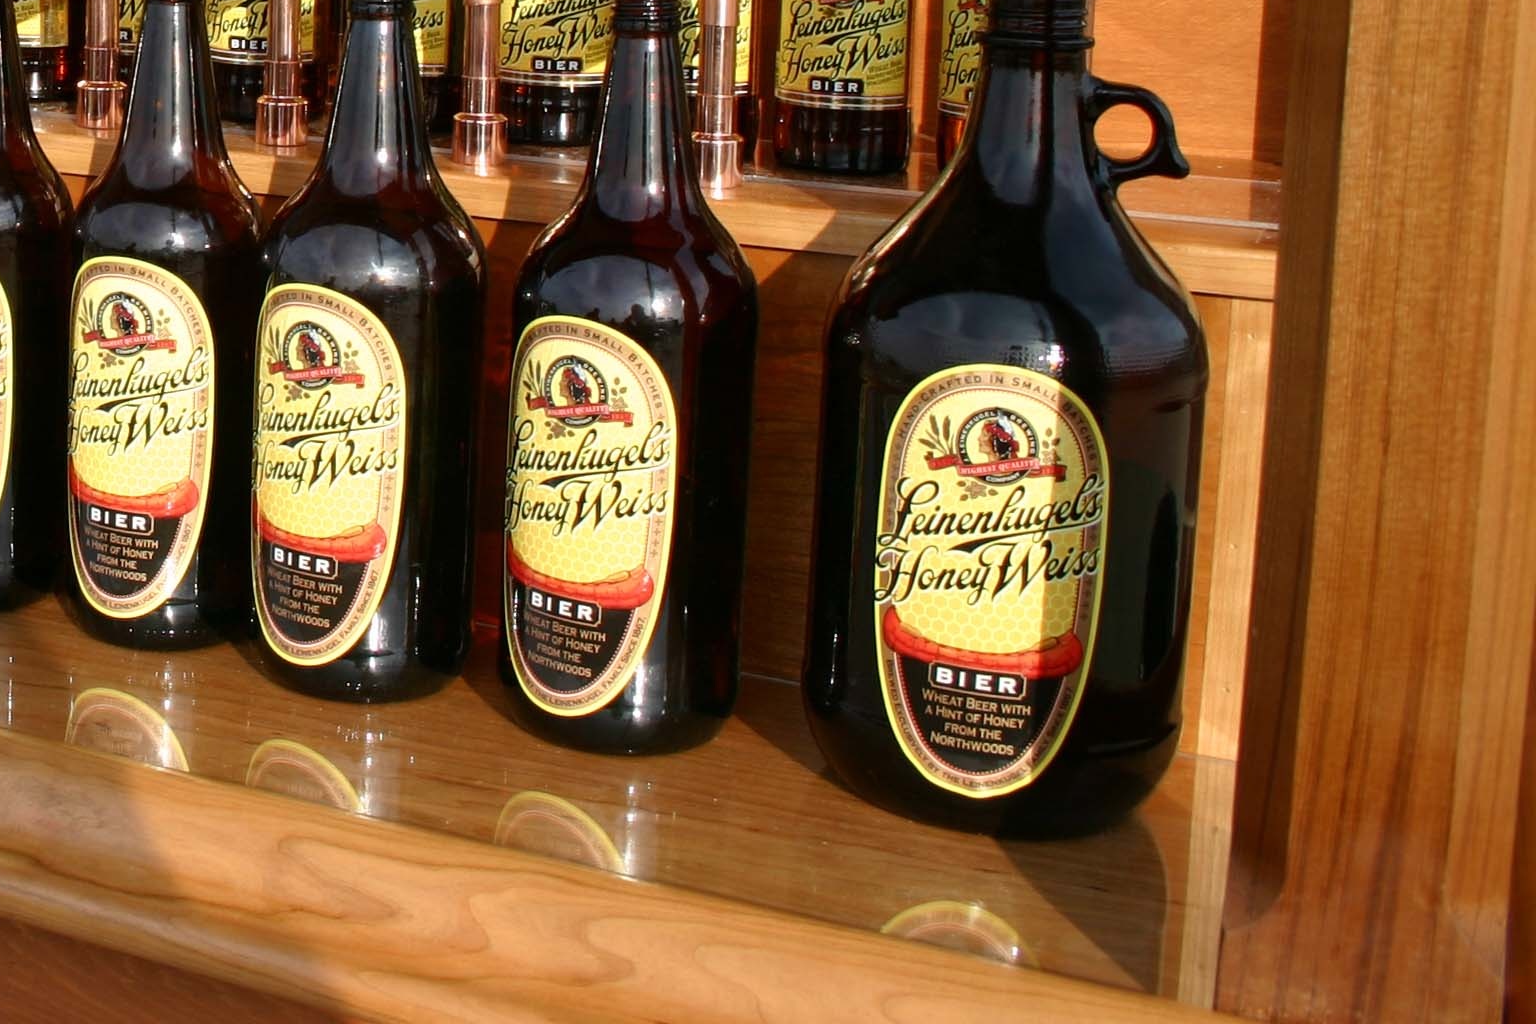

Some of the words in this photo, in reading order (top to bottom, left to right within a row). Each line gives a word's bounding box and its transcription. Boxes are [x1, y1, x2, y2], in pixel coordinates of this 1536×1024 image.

[501, 22, 565, 67] Honey
[535, 59, 579, 71] BIER
[781, 40, 845, 84] Honey
[837, 33, 905, 77] Weiss
[811, 80, 859, 93] BIER
[170, 285, 203, 337] BATCHES
[318, 295, 355, 318] SMALL
[359, 318, 393, 371] BATCHES
[566, 325, 577, 334] IN
[584, 328, 624, 354] SMALL
[628, 353, 663, 410] BATCHES
[989, 374, 1005, 385] IN
[1011, 377, 1059, 404] SMALL
[113, 402, 208, 455] Weiss
[505, 416, 672, 482] Leinenkugel's
[300, 439, 400, 491] Weiss
[960, 464, 997, 476] HIGHEST
[998, 459, 1041, 472] QUALITY
[90, 506, 147, 531] BIER
[504, 477, 572, 537] Honey
[562, 475, 669, 535] Weiss
[877, 473, 1106, 547] Leinenkugel's
[110, 533, 133, 546] BEER
[135, 538, 159, 549] WITH
[123, 547, 155, 560] HONEY
[97, 553, 119, 566] FROM
[120, 559, 137, 570] THE
[273, 547, 330, 575] BIER
[874, 545, 989, 606] Honey
[979, 539, 1101, 603] Weiss
[292, 575, 316, 590] BEER
[318, 582, 343, 595] WITH
[305, 590, 338, 606] HONEY
[303, 603, 320, 615] THE
[531, 591, 594, 621] BIER
[551, 621, 578, 636] BEER
[579, 628, 607, 642] WITH
[551, 635, 564, 645] OF
[565, 639, 602, 654] HONEY
[527, 650, 593, 678] NORTHWOODS
[536, 643, 561, 658] FROM
[563, 650, 582, 663] THE
[935, 666, 1017, 695] BIER
[921, 688, 963, 707] WHEAT
[965, 697, 998, 712] BEER
[1000, 702, 1031, 715] WITH
[924, 705, 933, 715] A
[935, 706, 963, 721] HINT
[965, 712, 980, 723] OF
[983, 714, 1025, 729] HONEY
[930, 730, 1015, 756] NORTHWOODS
[944, 722, 977, 738] FROM
[979, 728, 1002, 741] THE
